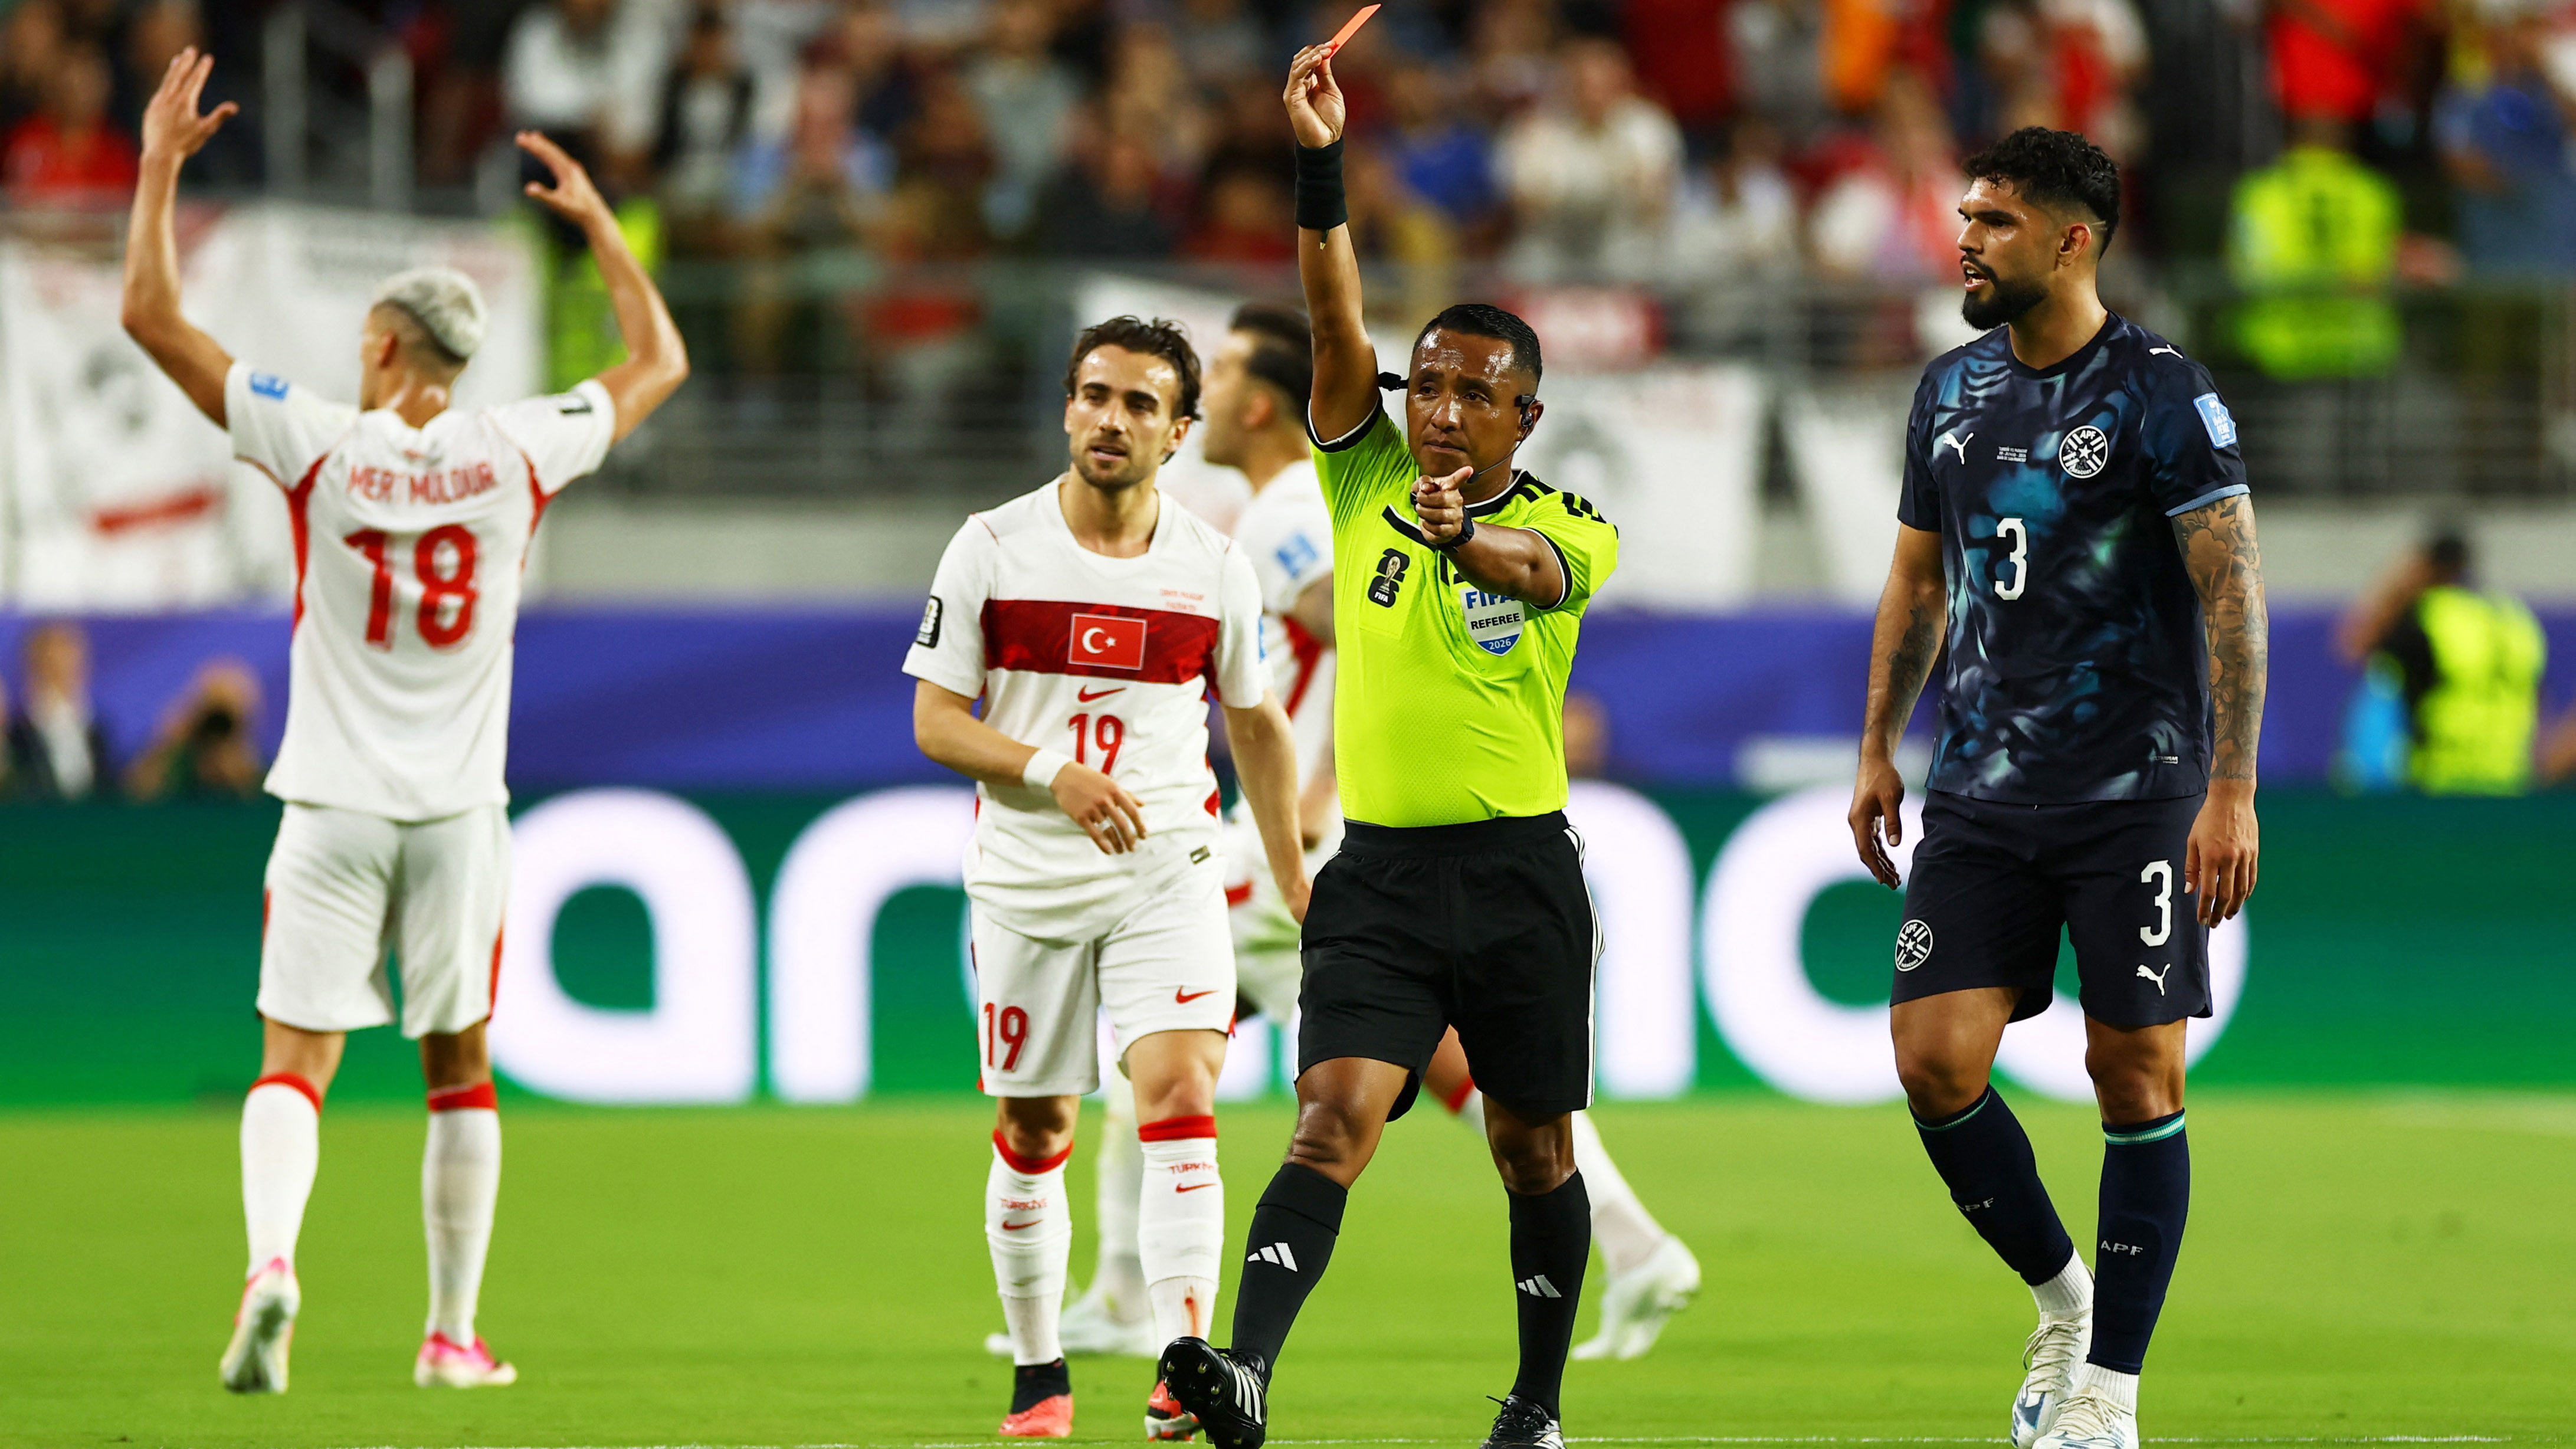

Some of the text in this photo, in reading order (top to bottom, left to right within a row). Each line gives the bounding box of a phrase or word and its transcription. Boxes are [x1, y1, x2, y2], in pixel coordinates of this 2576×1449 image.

[2080, 430, 2096, 440] APF
[1994, 517, 2027, 601] 3
[343, 524, 479, 653] 18
[1374, 591, 1389, 603] FIFA
[1470, 612, 1520, 630] REFEREE
[1489, 638, 1512, 650] 2026
[1068, 713, 1126, 778] 19
[2140, 860, 2172, 947] 3
[1905, 923, 1918, 935] APF
[984, 1002, 1029, 1072] 19
[2101, 1240, 2143, 1255] APF
